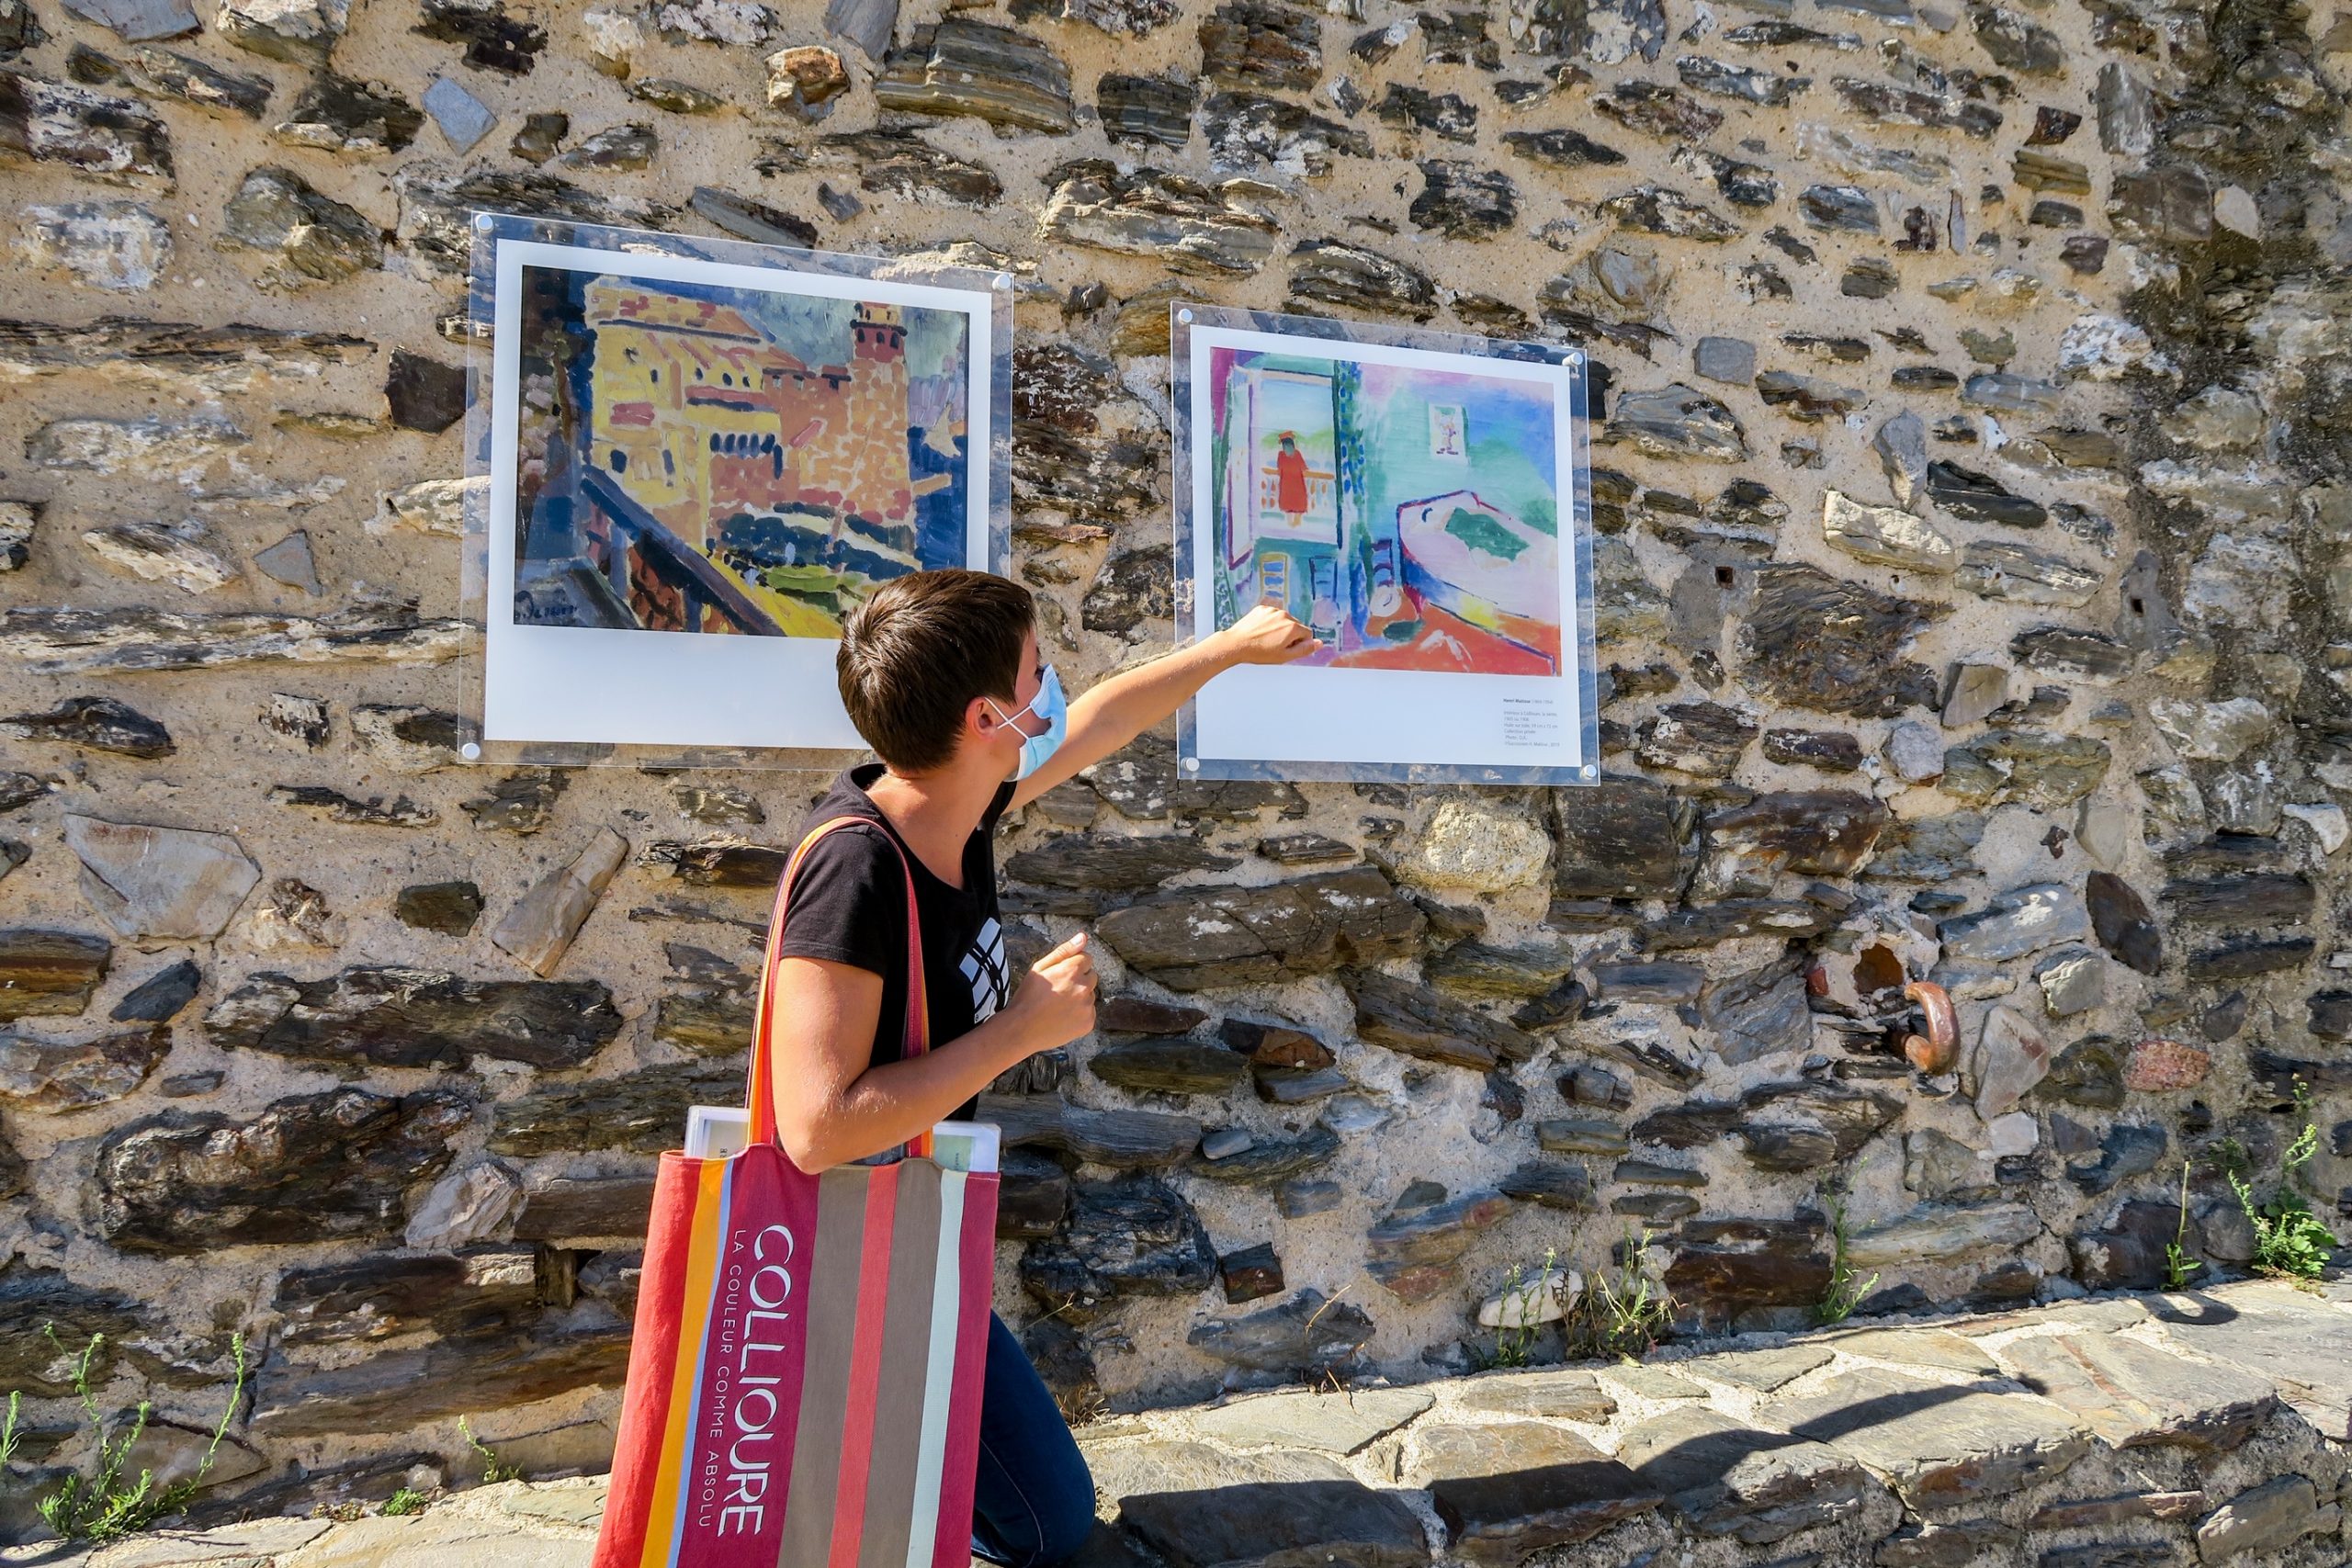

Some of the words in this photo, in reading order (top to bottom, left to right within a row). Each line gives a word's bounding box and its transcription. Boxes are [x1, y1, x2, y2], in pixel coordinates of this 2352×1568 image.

[732, 1229, 746, 1253] LA
[720, 1266, 742, 1354] COULEUR
[710, 1366, 730, 1438] COMME
[718, 1224, 794, 1538] COLLIOURE
[698, 1451, 719, 1528] ABSOLU
